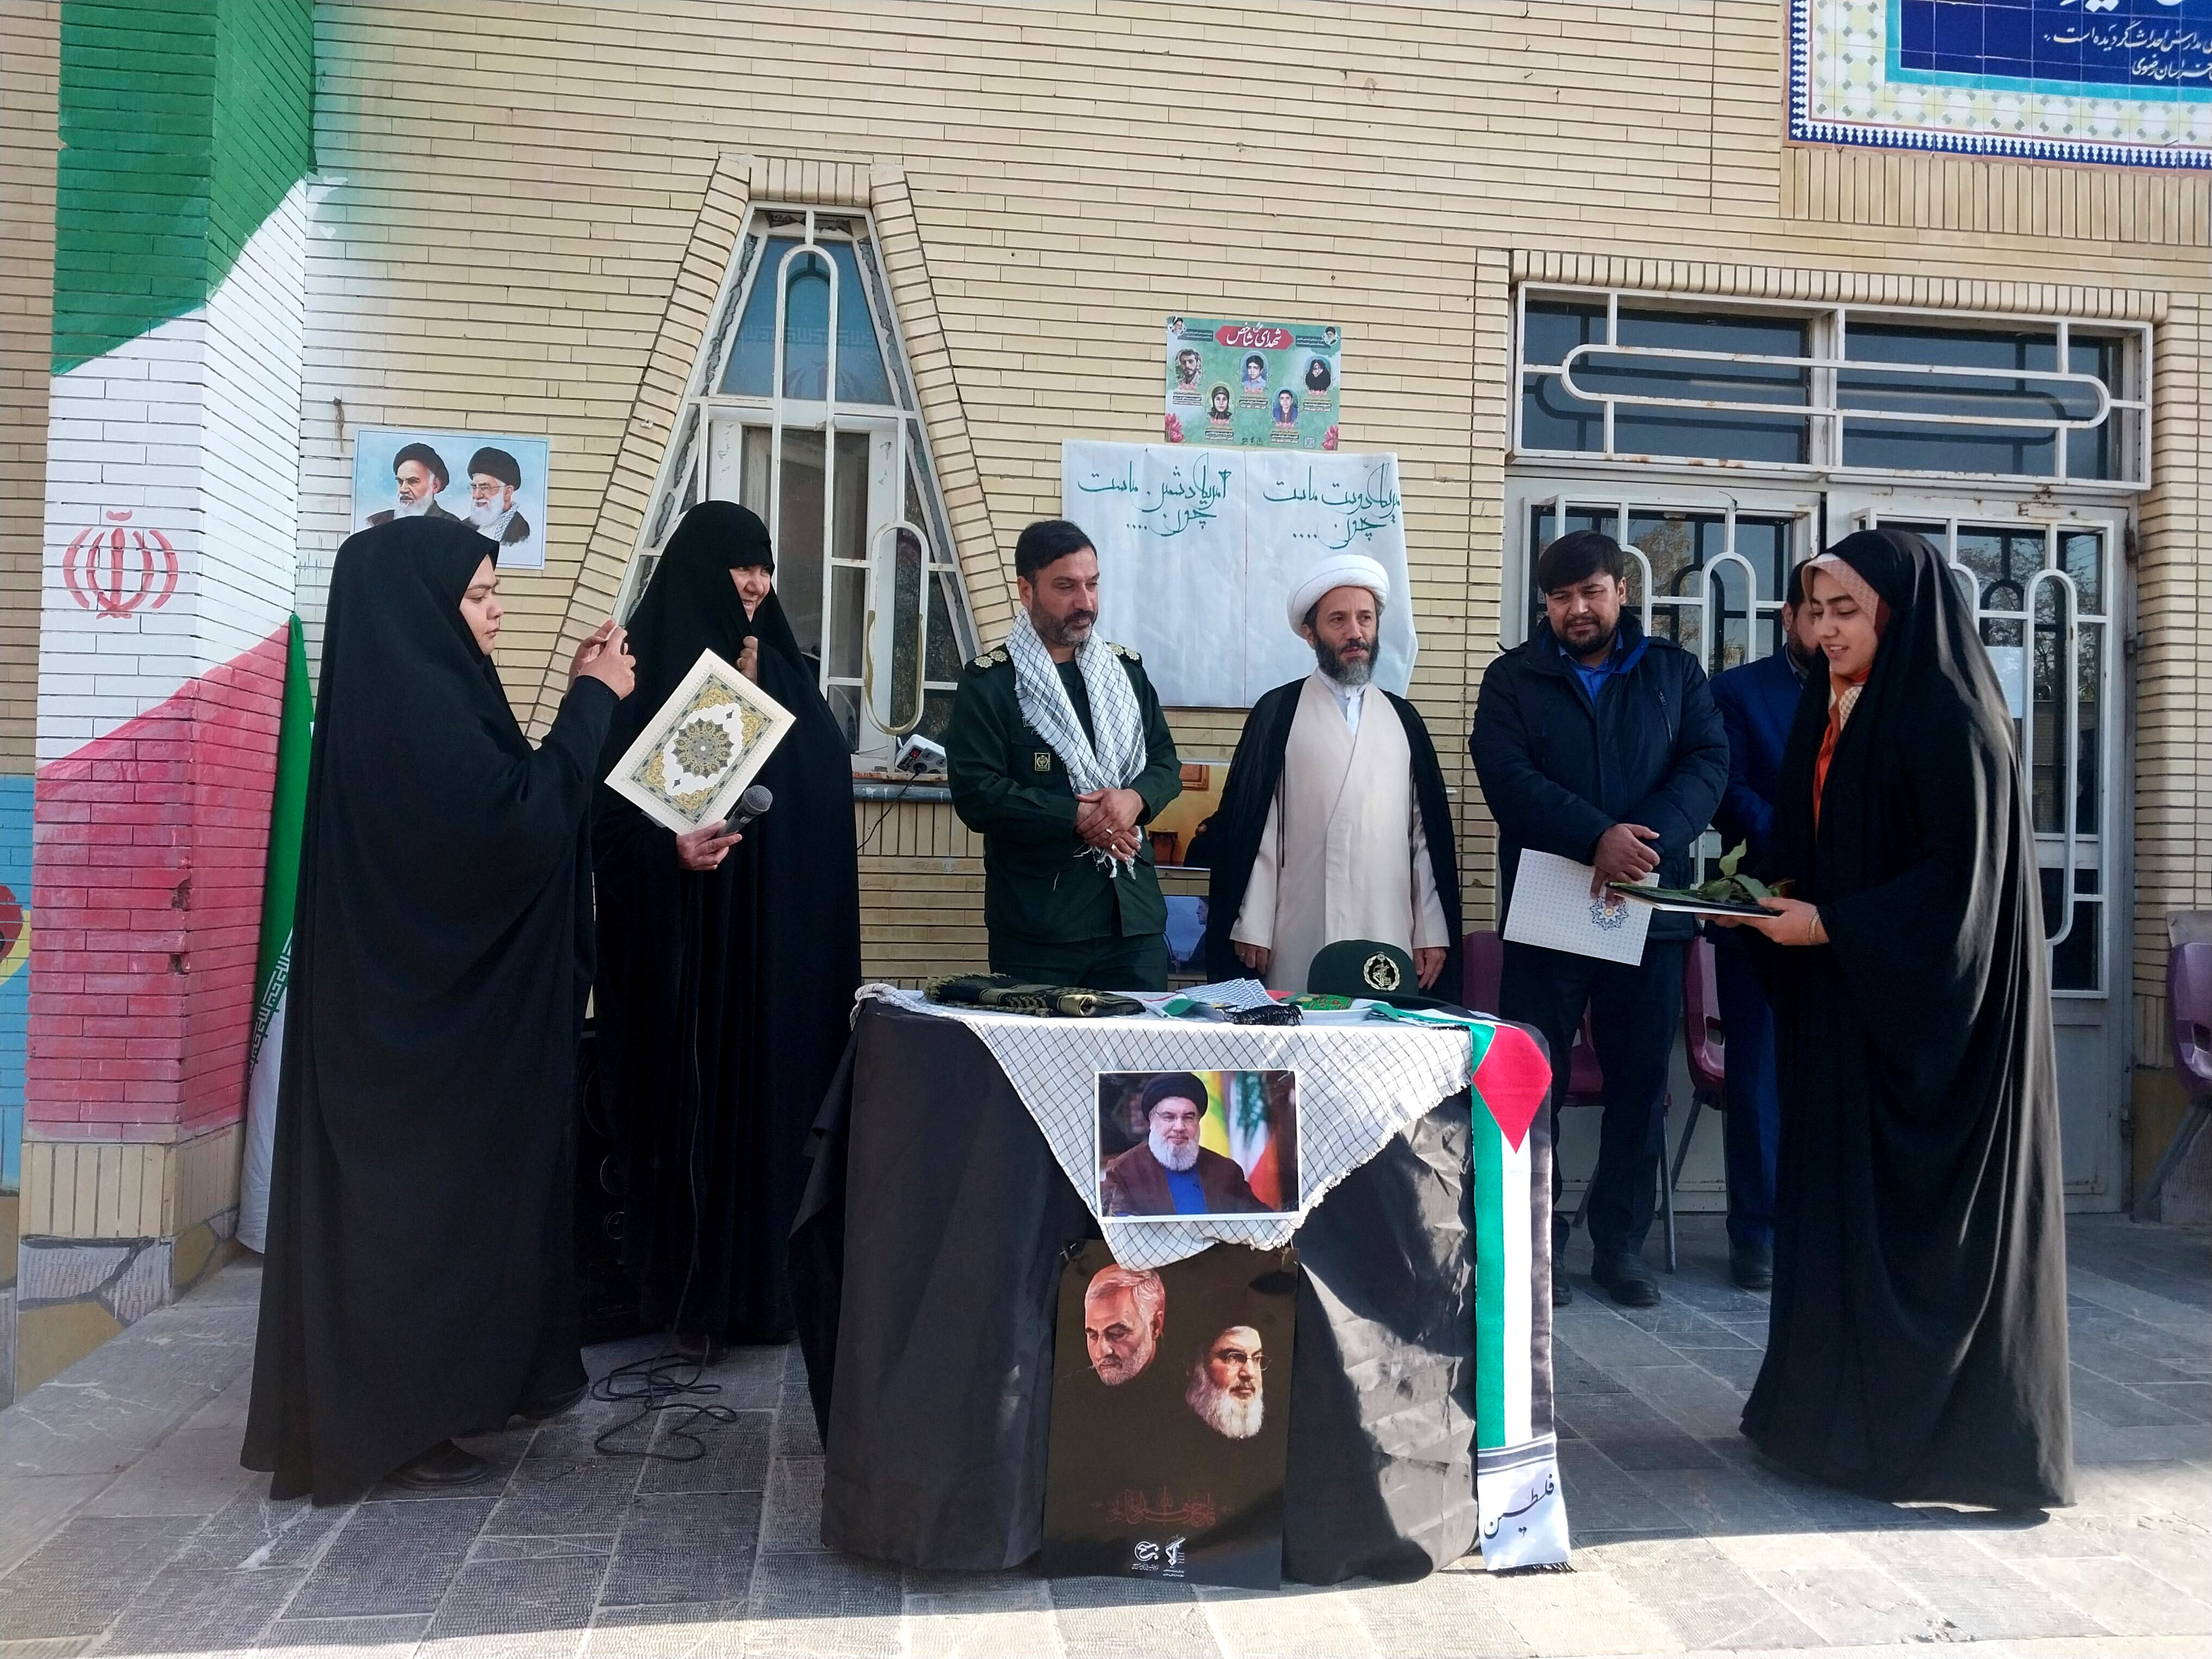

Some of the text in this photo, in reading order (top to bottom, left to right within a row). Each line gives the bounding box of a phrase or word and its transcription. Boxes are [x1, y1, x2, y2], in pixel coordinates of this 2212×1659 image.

[2132, 54, 2159, 76] رضوی
[1226, 321, 1282, 348] شهدای شاخص
[1078, 460, 1139, 493] ماست
[1131, 466, 1196, 513] دشمن
[1263, 465, 1318, 502] ماست
[1321, 483, 1372, 515] دوست
[1148, 509, 1217, 537] چون
[1317, 517, 1387, 550] چون
[1484, 1474, 1555, 1539] فلسطین
